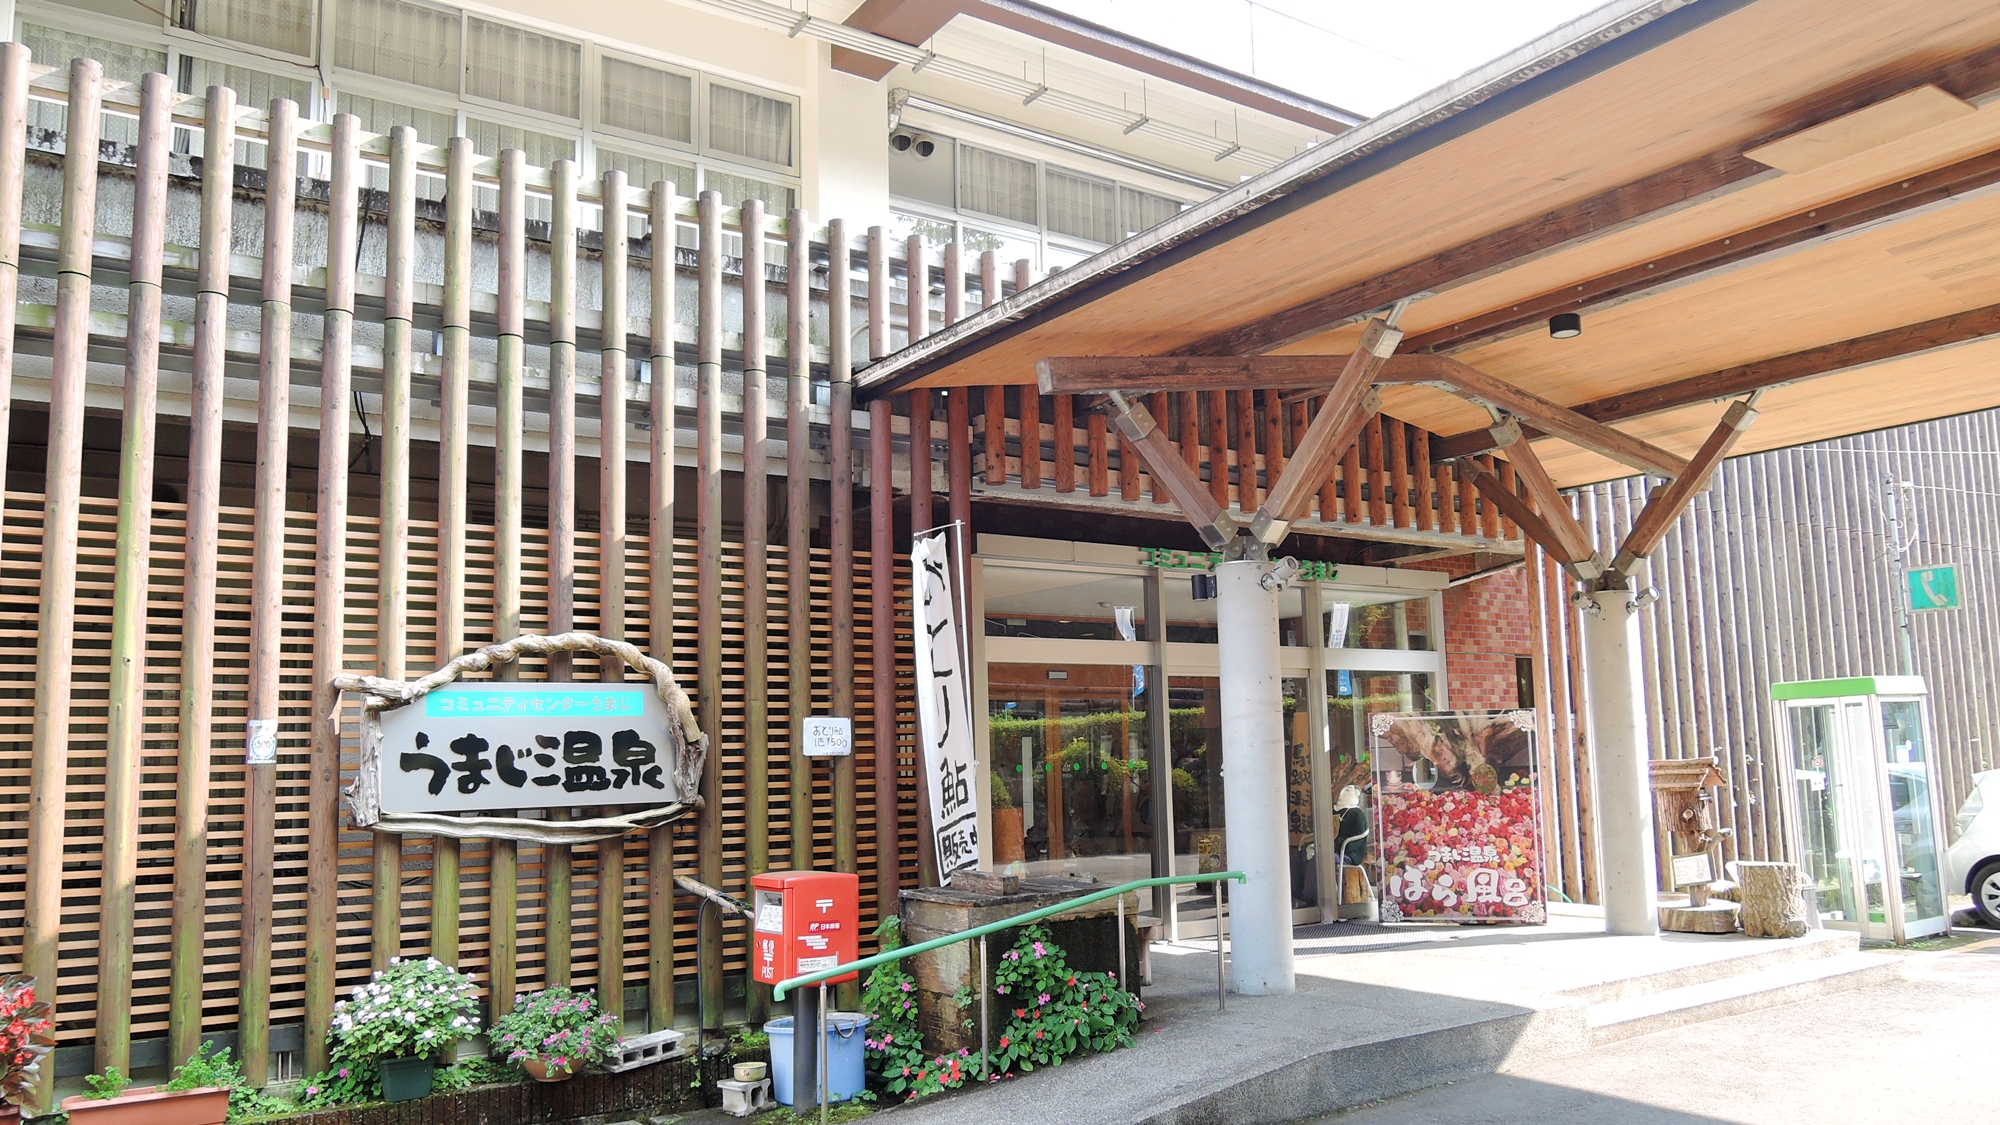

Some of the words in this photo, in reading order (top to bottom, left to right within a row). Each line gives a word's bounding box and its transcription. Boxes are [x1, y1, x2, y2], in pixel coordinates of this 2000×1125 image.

[440, 696, 631, 712] コミュニティセンターうまじ
[399, 729, 665, 796] うまじ温泉
[1427, 846, 1501, 863] うまじ温泉
[1390, 859, 1529, 907] ばら風呂
[761, 966, 774, 979] POST
